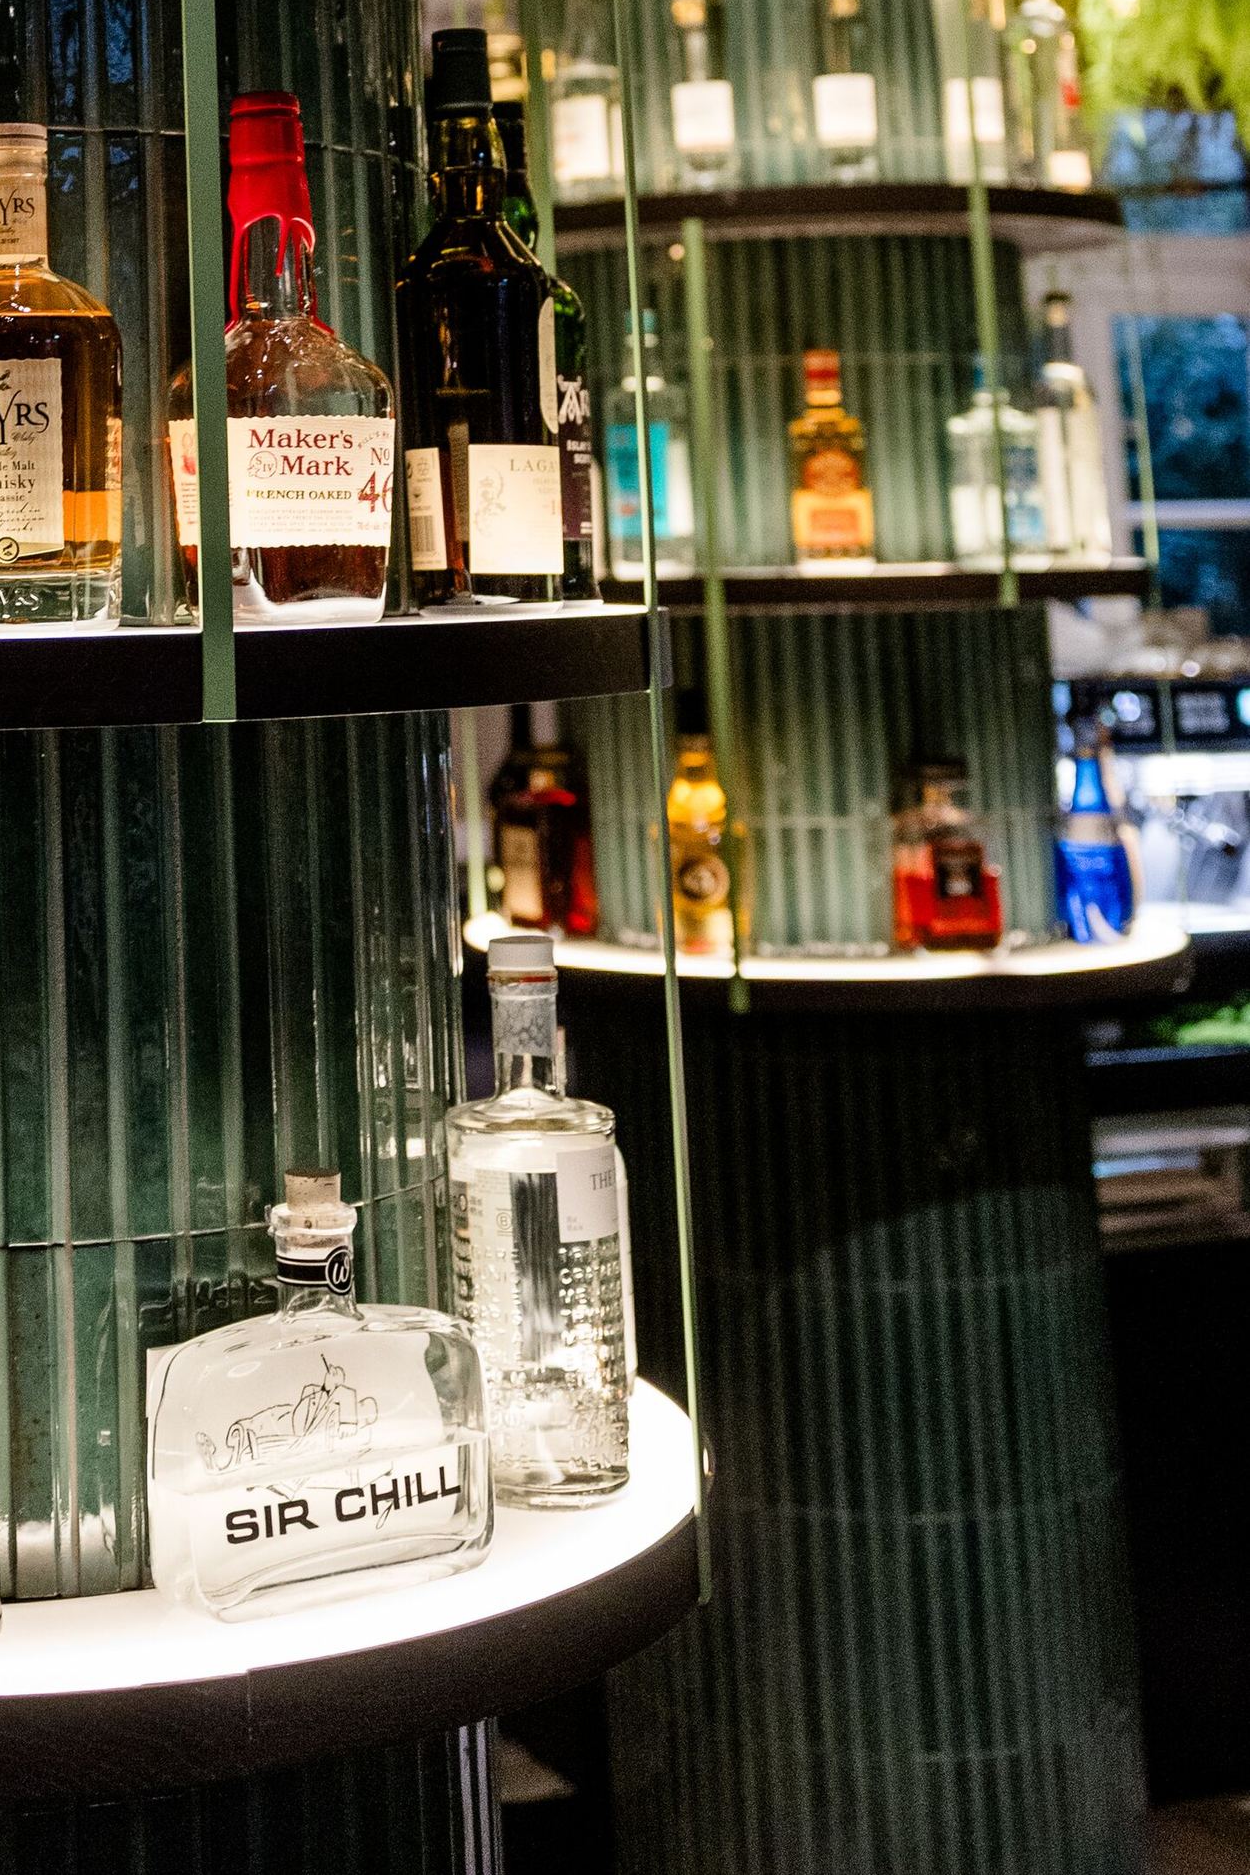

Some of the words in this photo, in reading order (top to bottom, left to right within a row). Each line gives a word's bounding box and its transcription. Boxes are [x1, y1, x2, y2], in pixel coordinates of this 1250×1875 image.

[247, 429, 354, 449] Maker's
[11, 460, 35, 471] Malt
[280, 455, 352, 475] Mark
[247, 490, 305, 500] FRENCH
[308, 490, 352, 500] OAKED
[226, 1499, 319, 1544] SIR
[335, 1466, 461, 1522] CHILL
